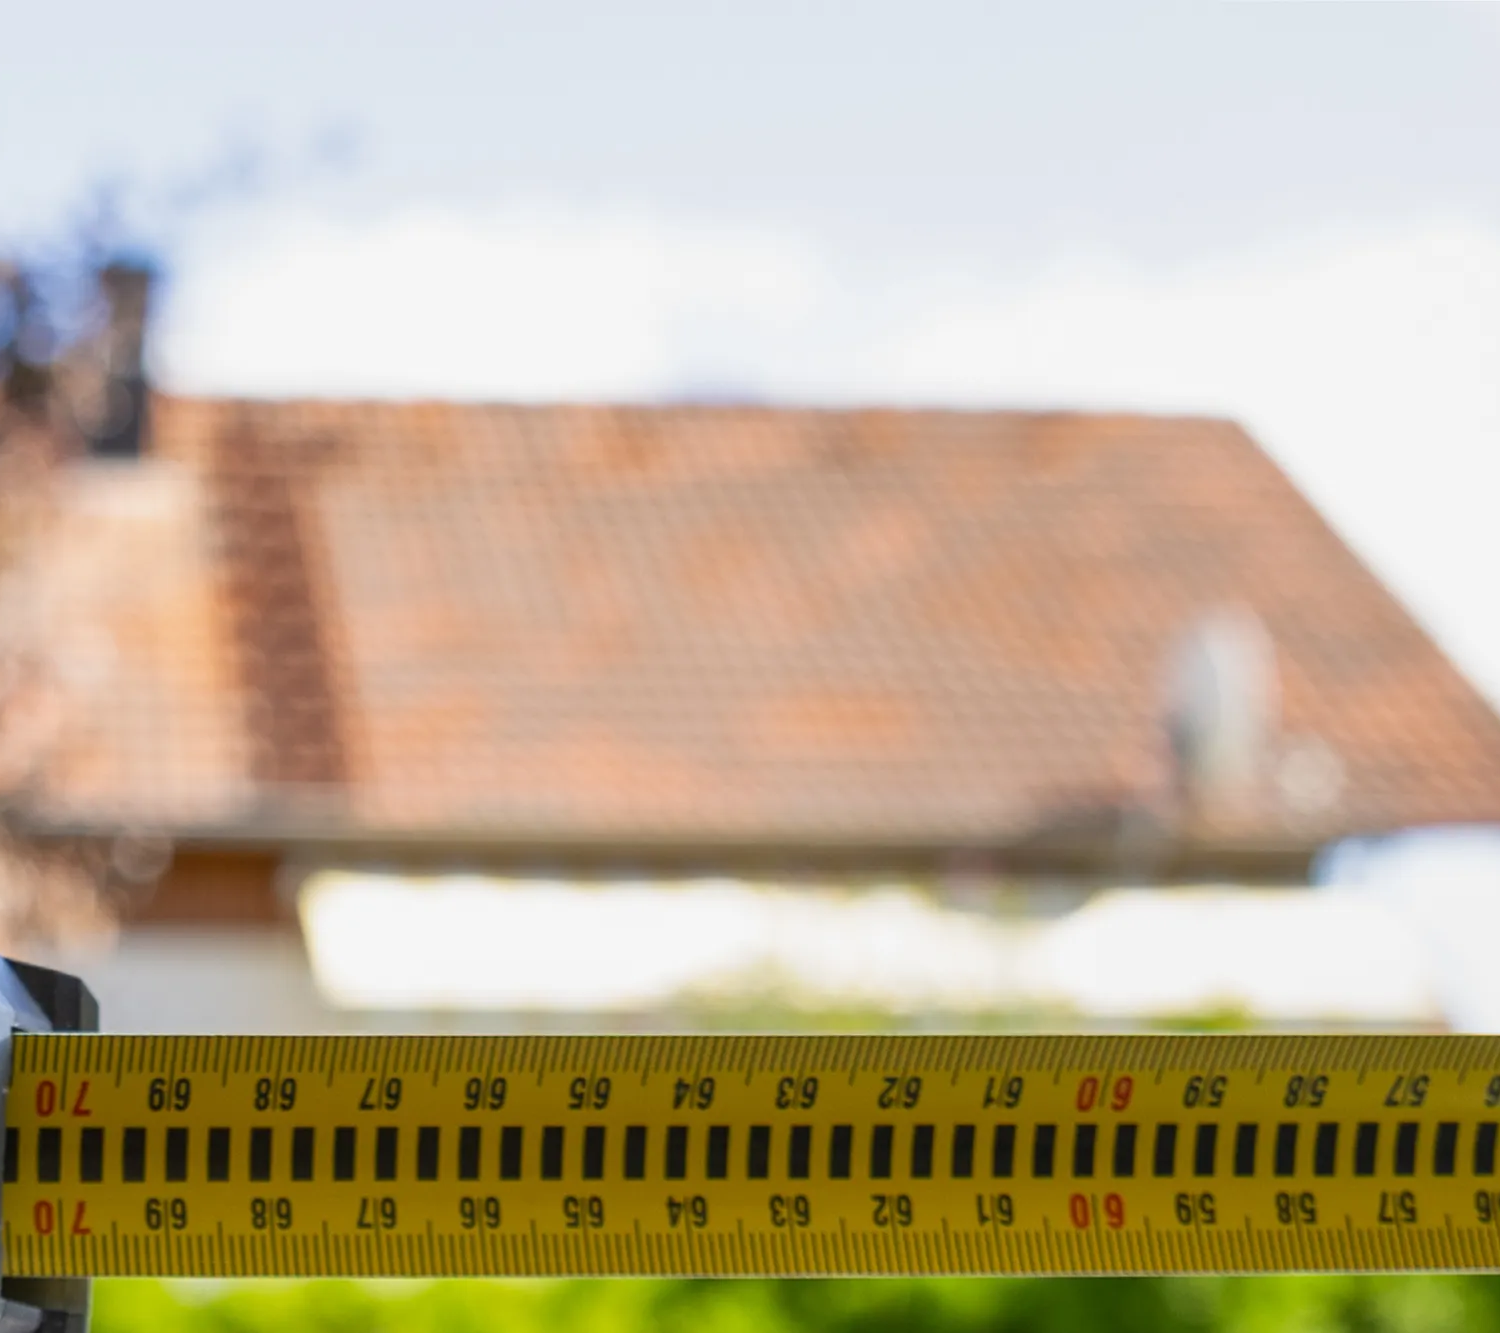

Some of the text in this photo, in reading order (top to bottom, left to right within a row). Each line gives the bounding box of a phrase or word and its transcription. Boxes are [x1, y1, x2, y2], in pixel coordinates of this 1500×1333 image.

[36, 1081, 92, 1117] 70
[148, 1078, 191, 1112] 69
[254, 1078, 297, 1111] 68
[359, 1078, 402, 1111] 67
[464, 1078, 507, 1111] 66
[569, 1078, 611, 1110] 65
[673, 1077, 715, 1110] 64
[775, 1077, 819, 1110] 63
[878, 1076, 922, 1109] 62
[983, 1076, 1023, 1109] 61
[1076, 1076, 1133, 1113] 60
[1183, 1075, 1227, 1108] 59
[34, 1201, 92, 1236] 70
[145, 1199, 188, 1230] 69
[251, 1199, 293, 1230] 68
[357, 1198, 398, 1230] 67
[459, 1198, 501, 1229] 66
[563, 1197, 604, 1229] 65
[666, 1196, 708, 1228] 64
[769, 1195, 810, 1227] 63
[872, 1195, 913, 1227] 62
[976, 1195, 1014, 1227] 61
[1070, 1194, 1125, 1230] 60
[1175, 1194, 1217, 1226] 59
